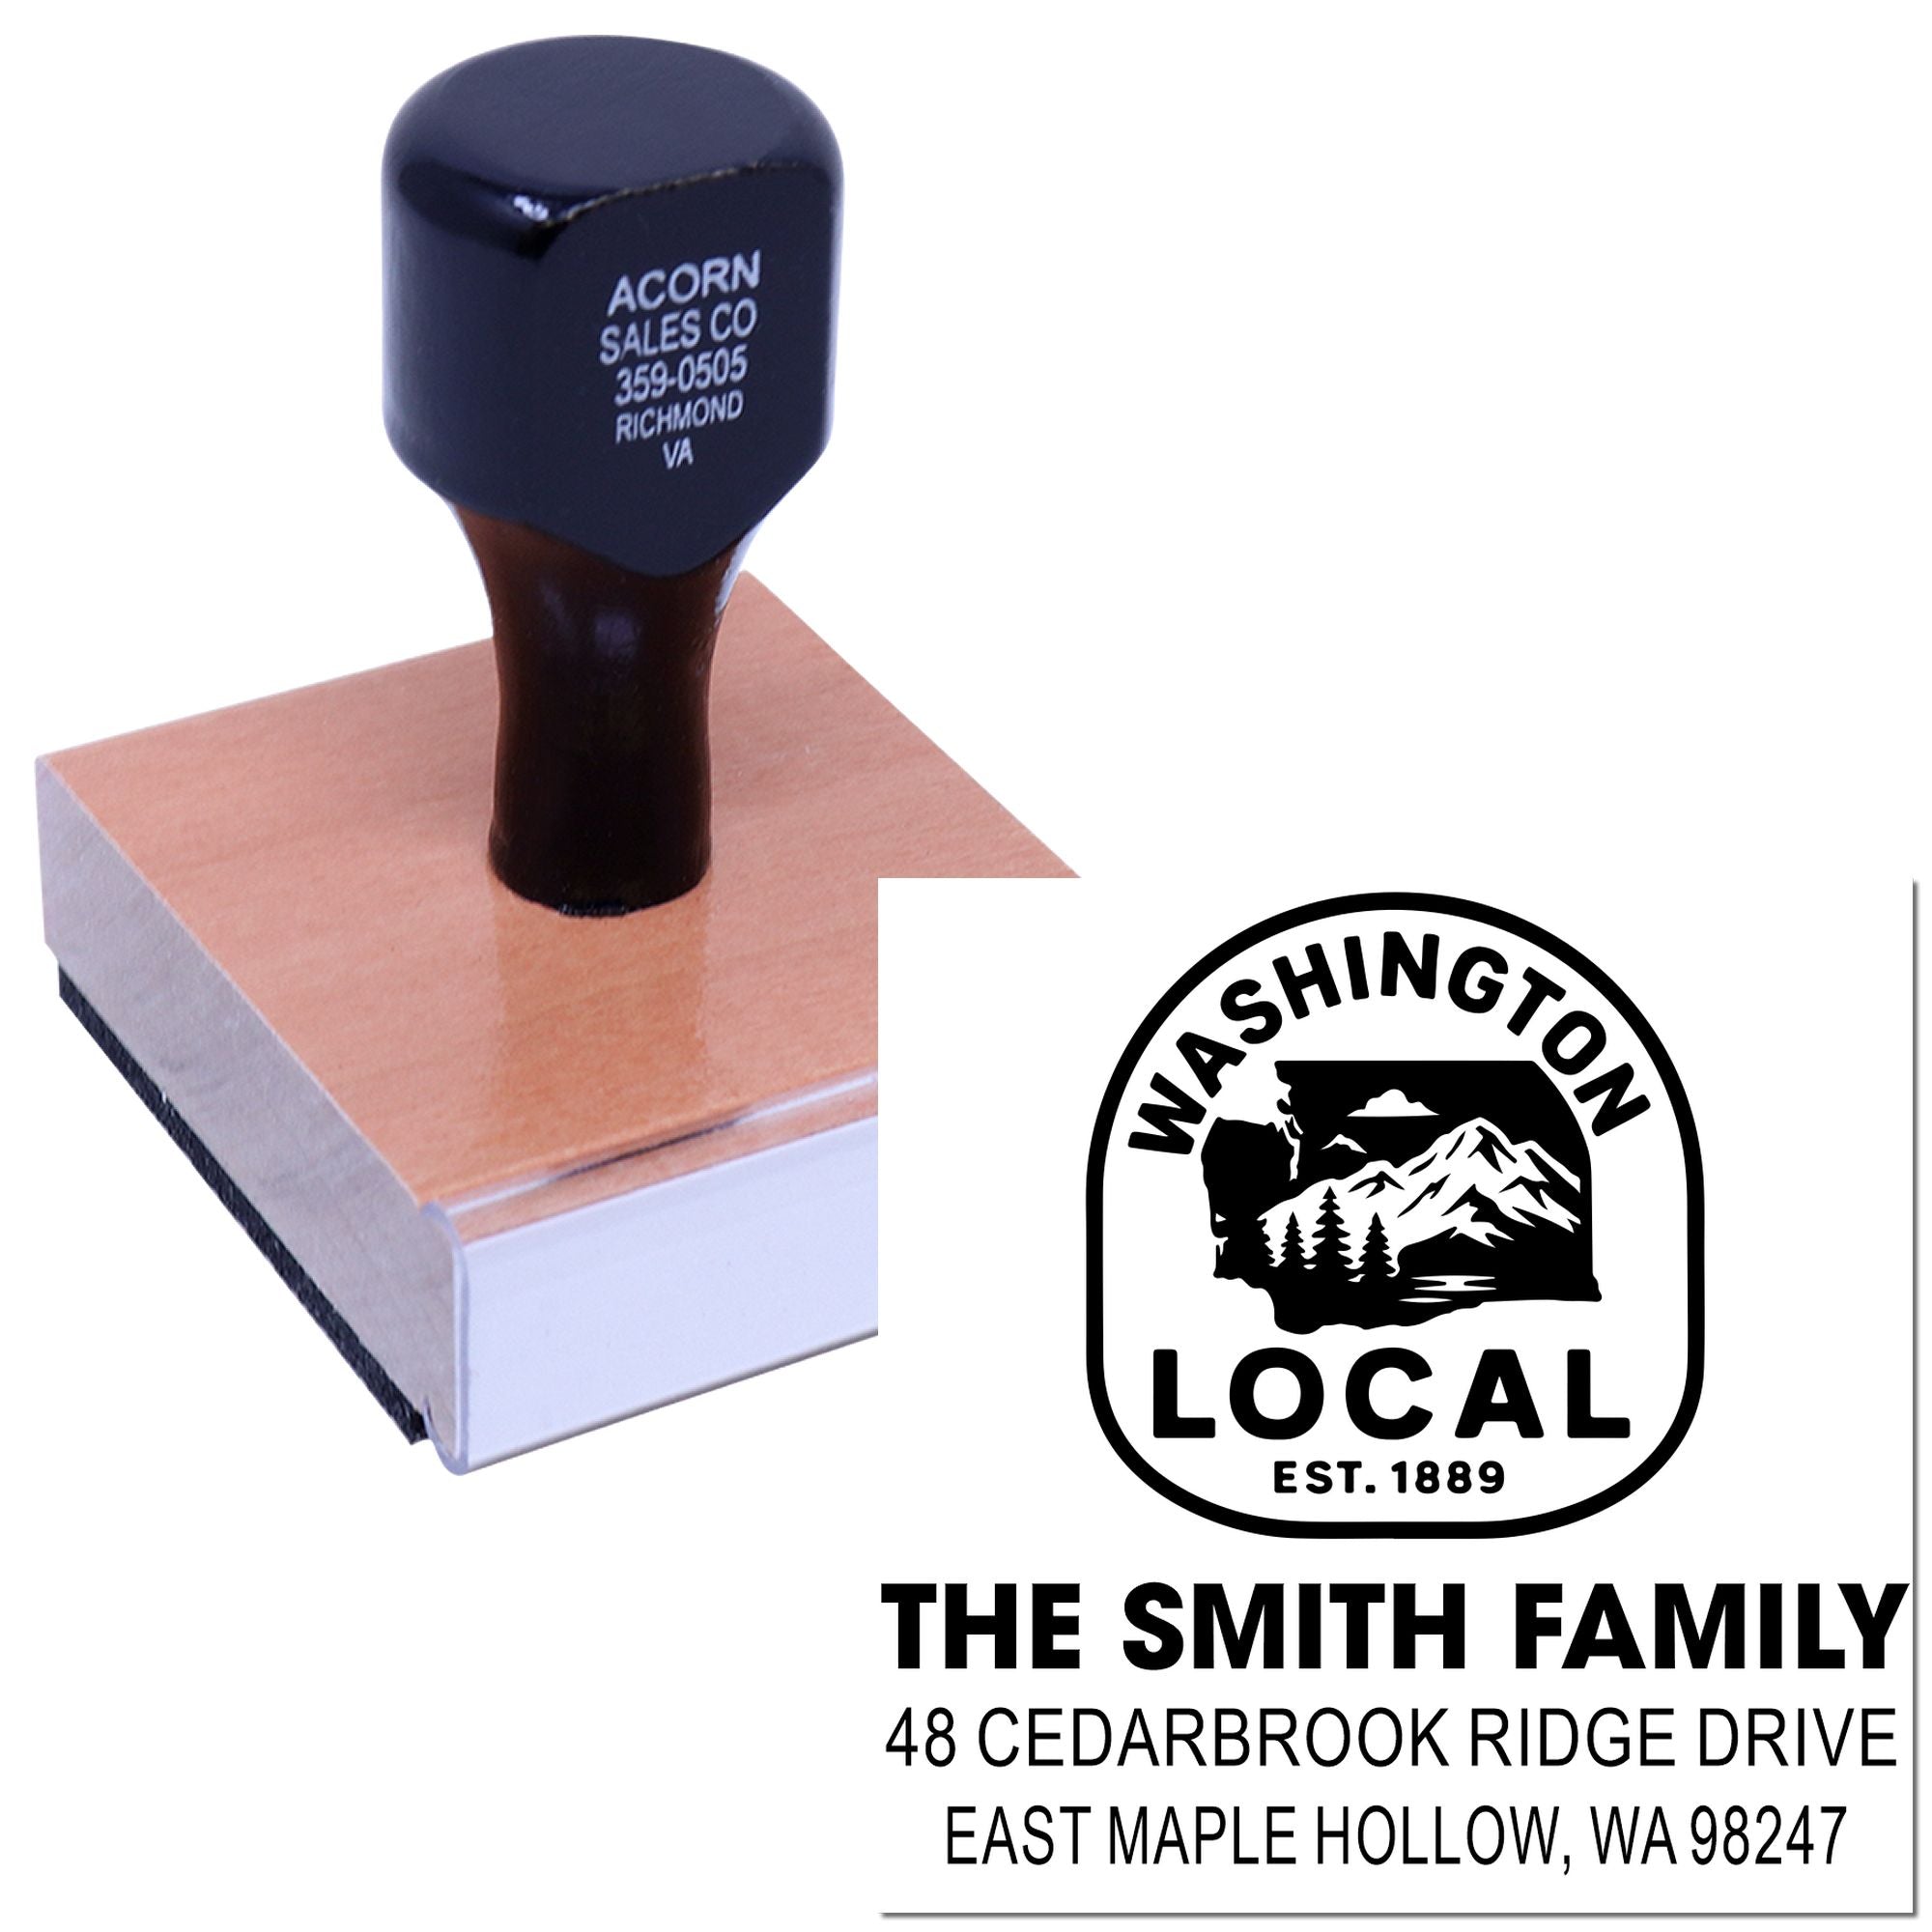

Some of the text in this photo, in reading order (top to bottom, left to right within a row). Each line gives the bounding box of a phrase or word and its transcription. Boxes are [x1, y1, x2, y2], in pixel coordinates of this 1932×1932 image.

[607, 249, 760, 317] ACORN
[599, 298, 757, 365] SALES CO
[614, 344, 748, 407] 359-0505
[614, 389, 744, 444] RICHMOND
[663, 437, 695, 469] VA
